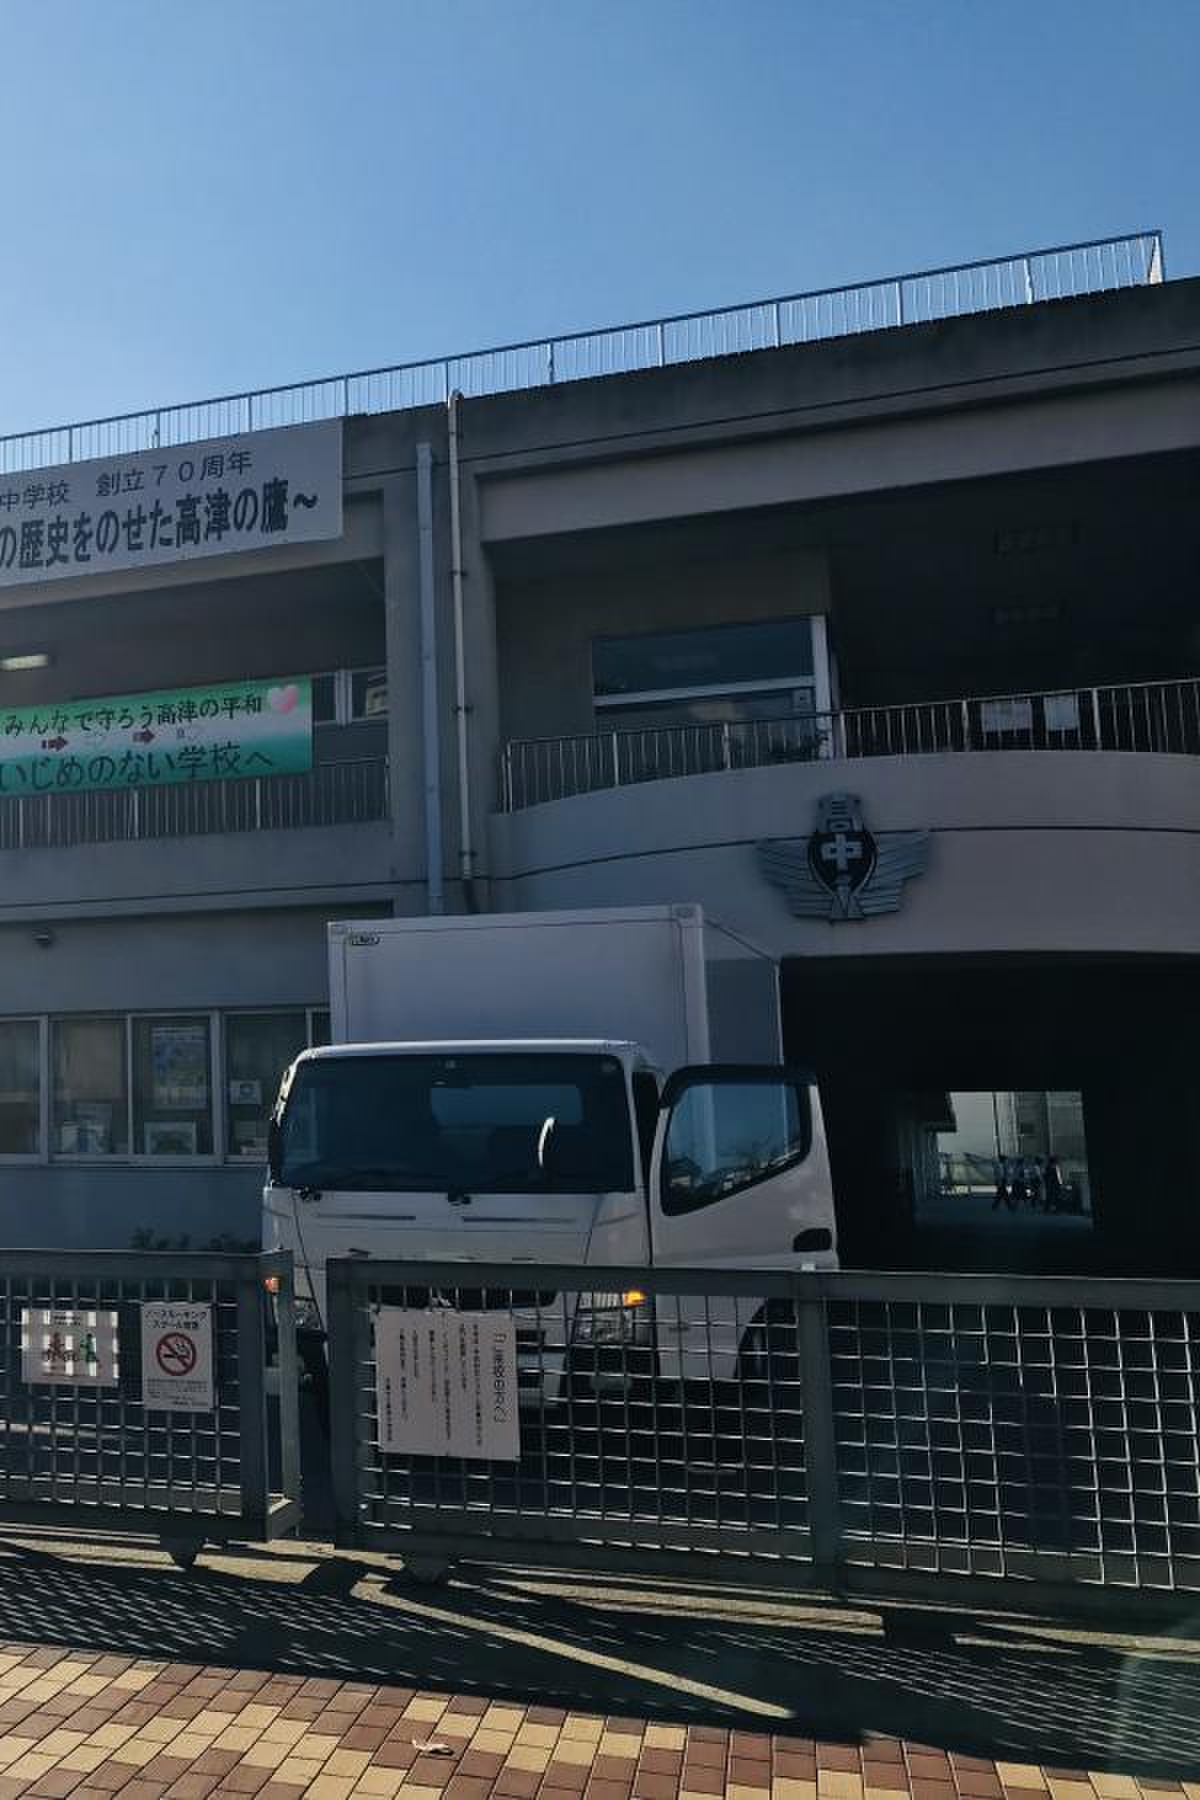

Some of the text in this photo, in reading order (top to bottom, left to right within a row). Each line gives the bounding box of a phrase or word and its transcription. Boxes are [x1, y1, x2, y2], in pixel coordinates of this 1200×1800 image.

[5, 696, 262, 737] みんなで守ろう高津の平和
